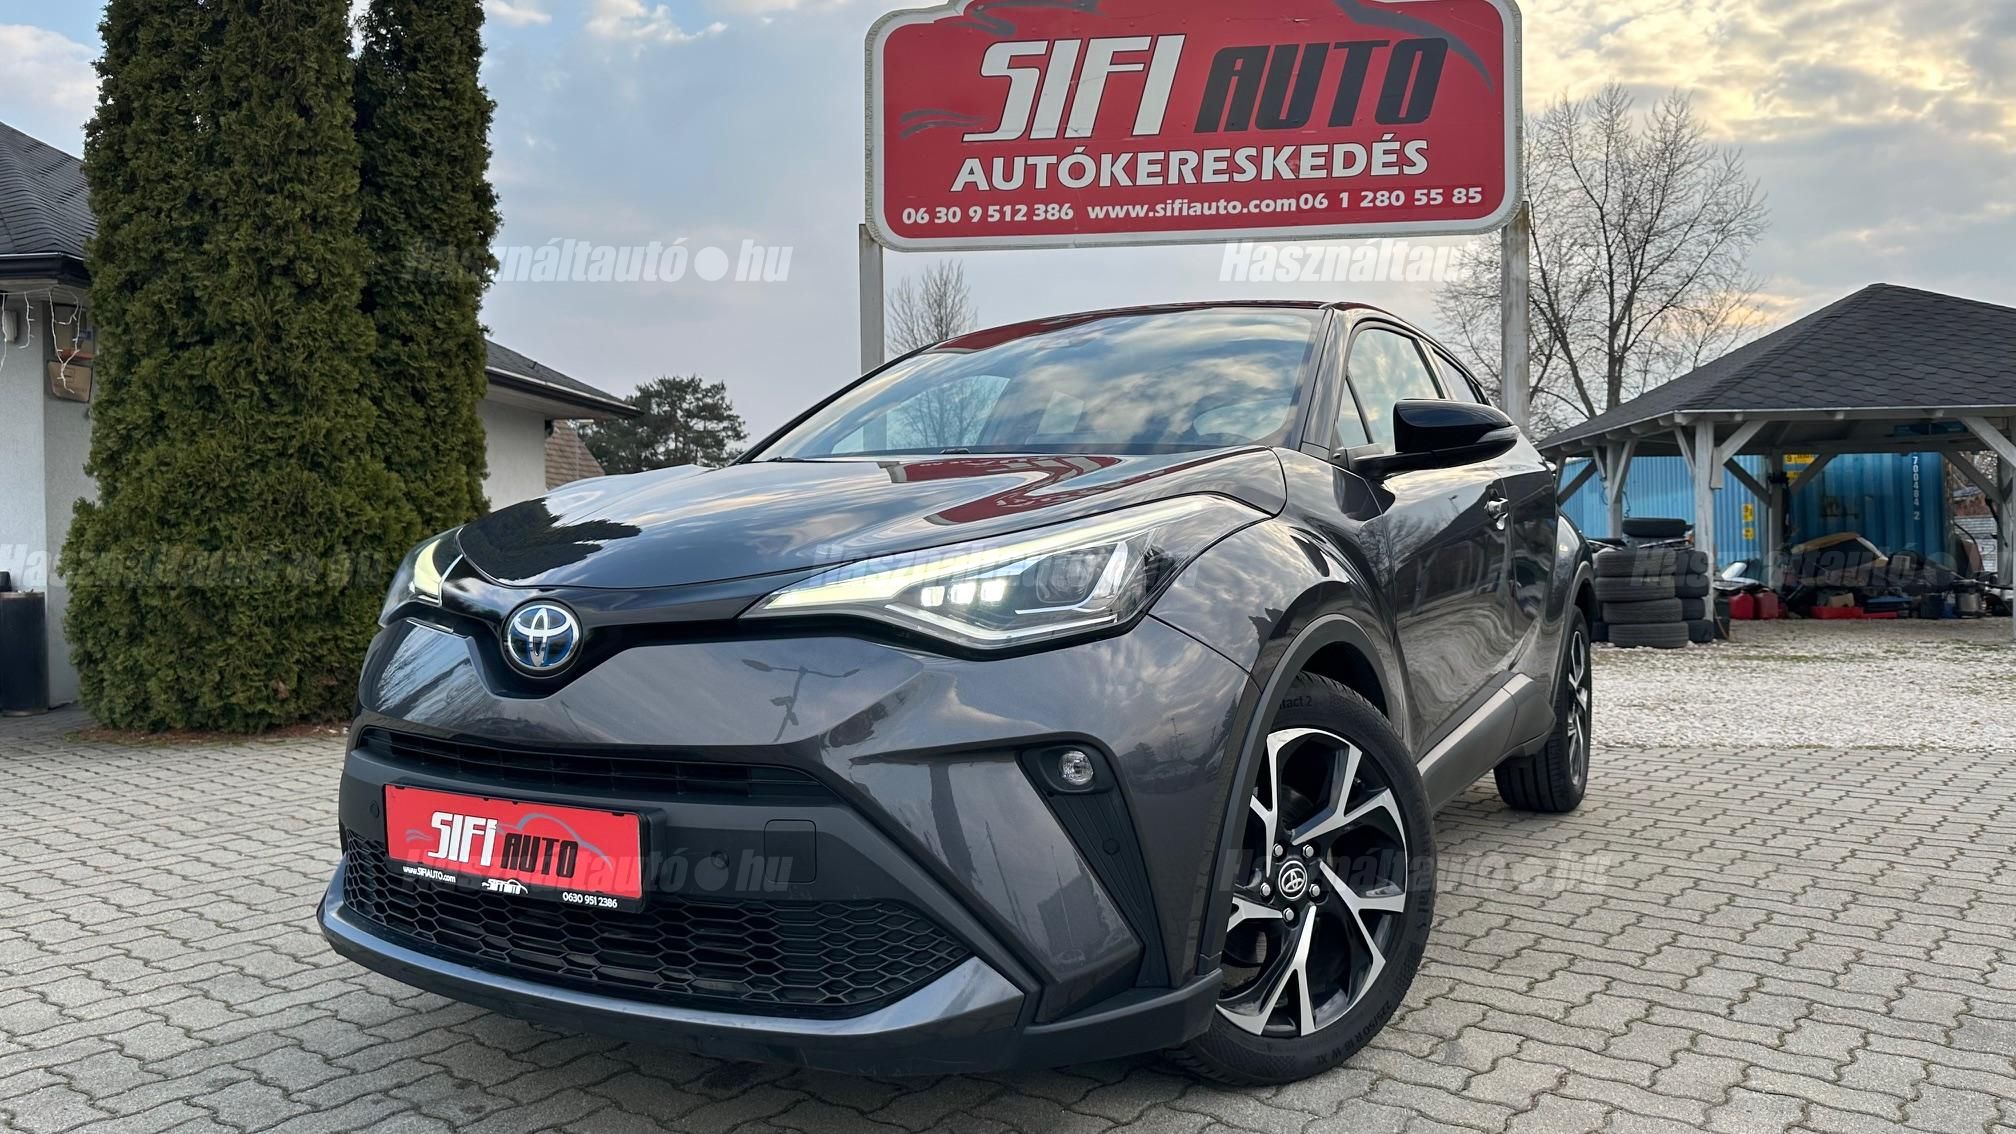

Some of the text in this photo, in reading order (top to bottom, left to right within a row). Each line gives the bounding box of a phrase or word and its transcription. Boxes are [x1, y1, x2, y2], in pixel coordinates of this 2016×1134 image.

[962, 34, 1449, 142] SIFI AUTO
[949, 133, 1429, 192] AUTÓKERESKEDÉS
[902, 207, 929, 224] 06
[934, 207, 961, 223] 30
[987, 204, 1027, 222] 512
[1032, 203, 1074, 220] 386
[1087, 198, 1297, 219] www.sifiauto.com
[1299, 192, 1328, 210] 06
[1339, 192, 1349, 208] 1
[1360, 190, 1405, 207] 280
[1414, 189, 1443, 205] 55
[1452, 187, 1482, 204] 85
[427, 811, 579, 878] SIFI AUTO
[562, 891, 583, 904] 0630
